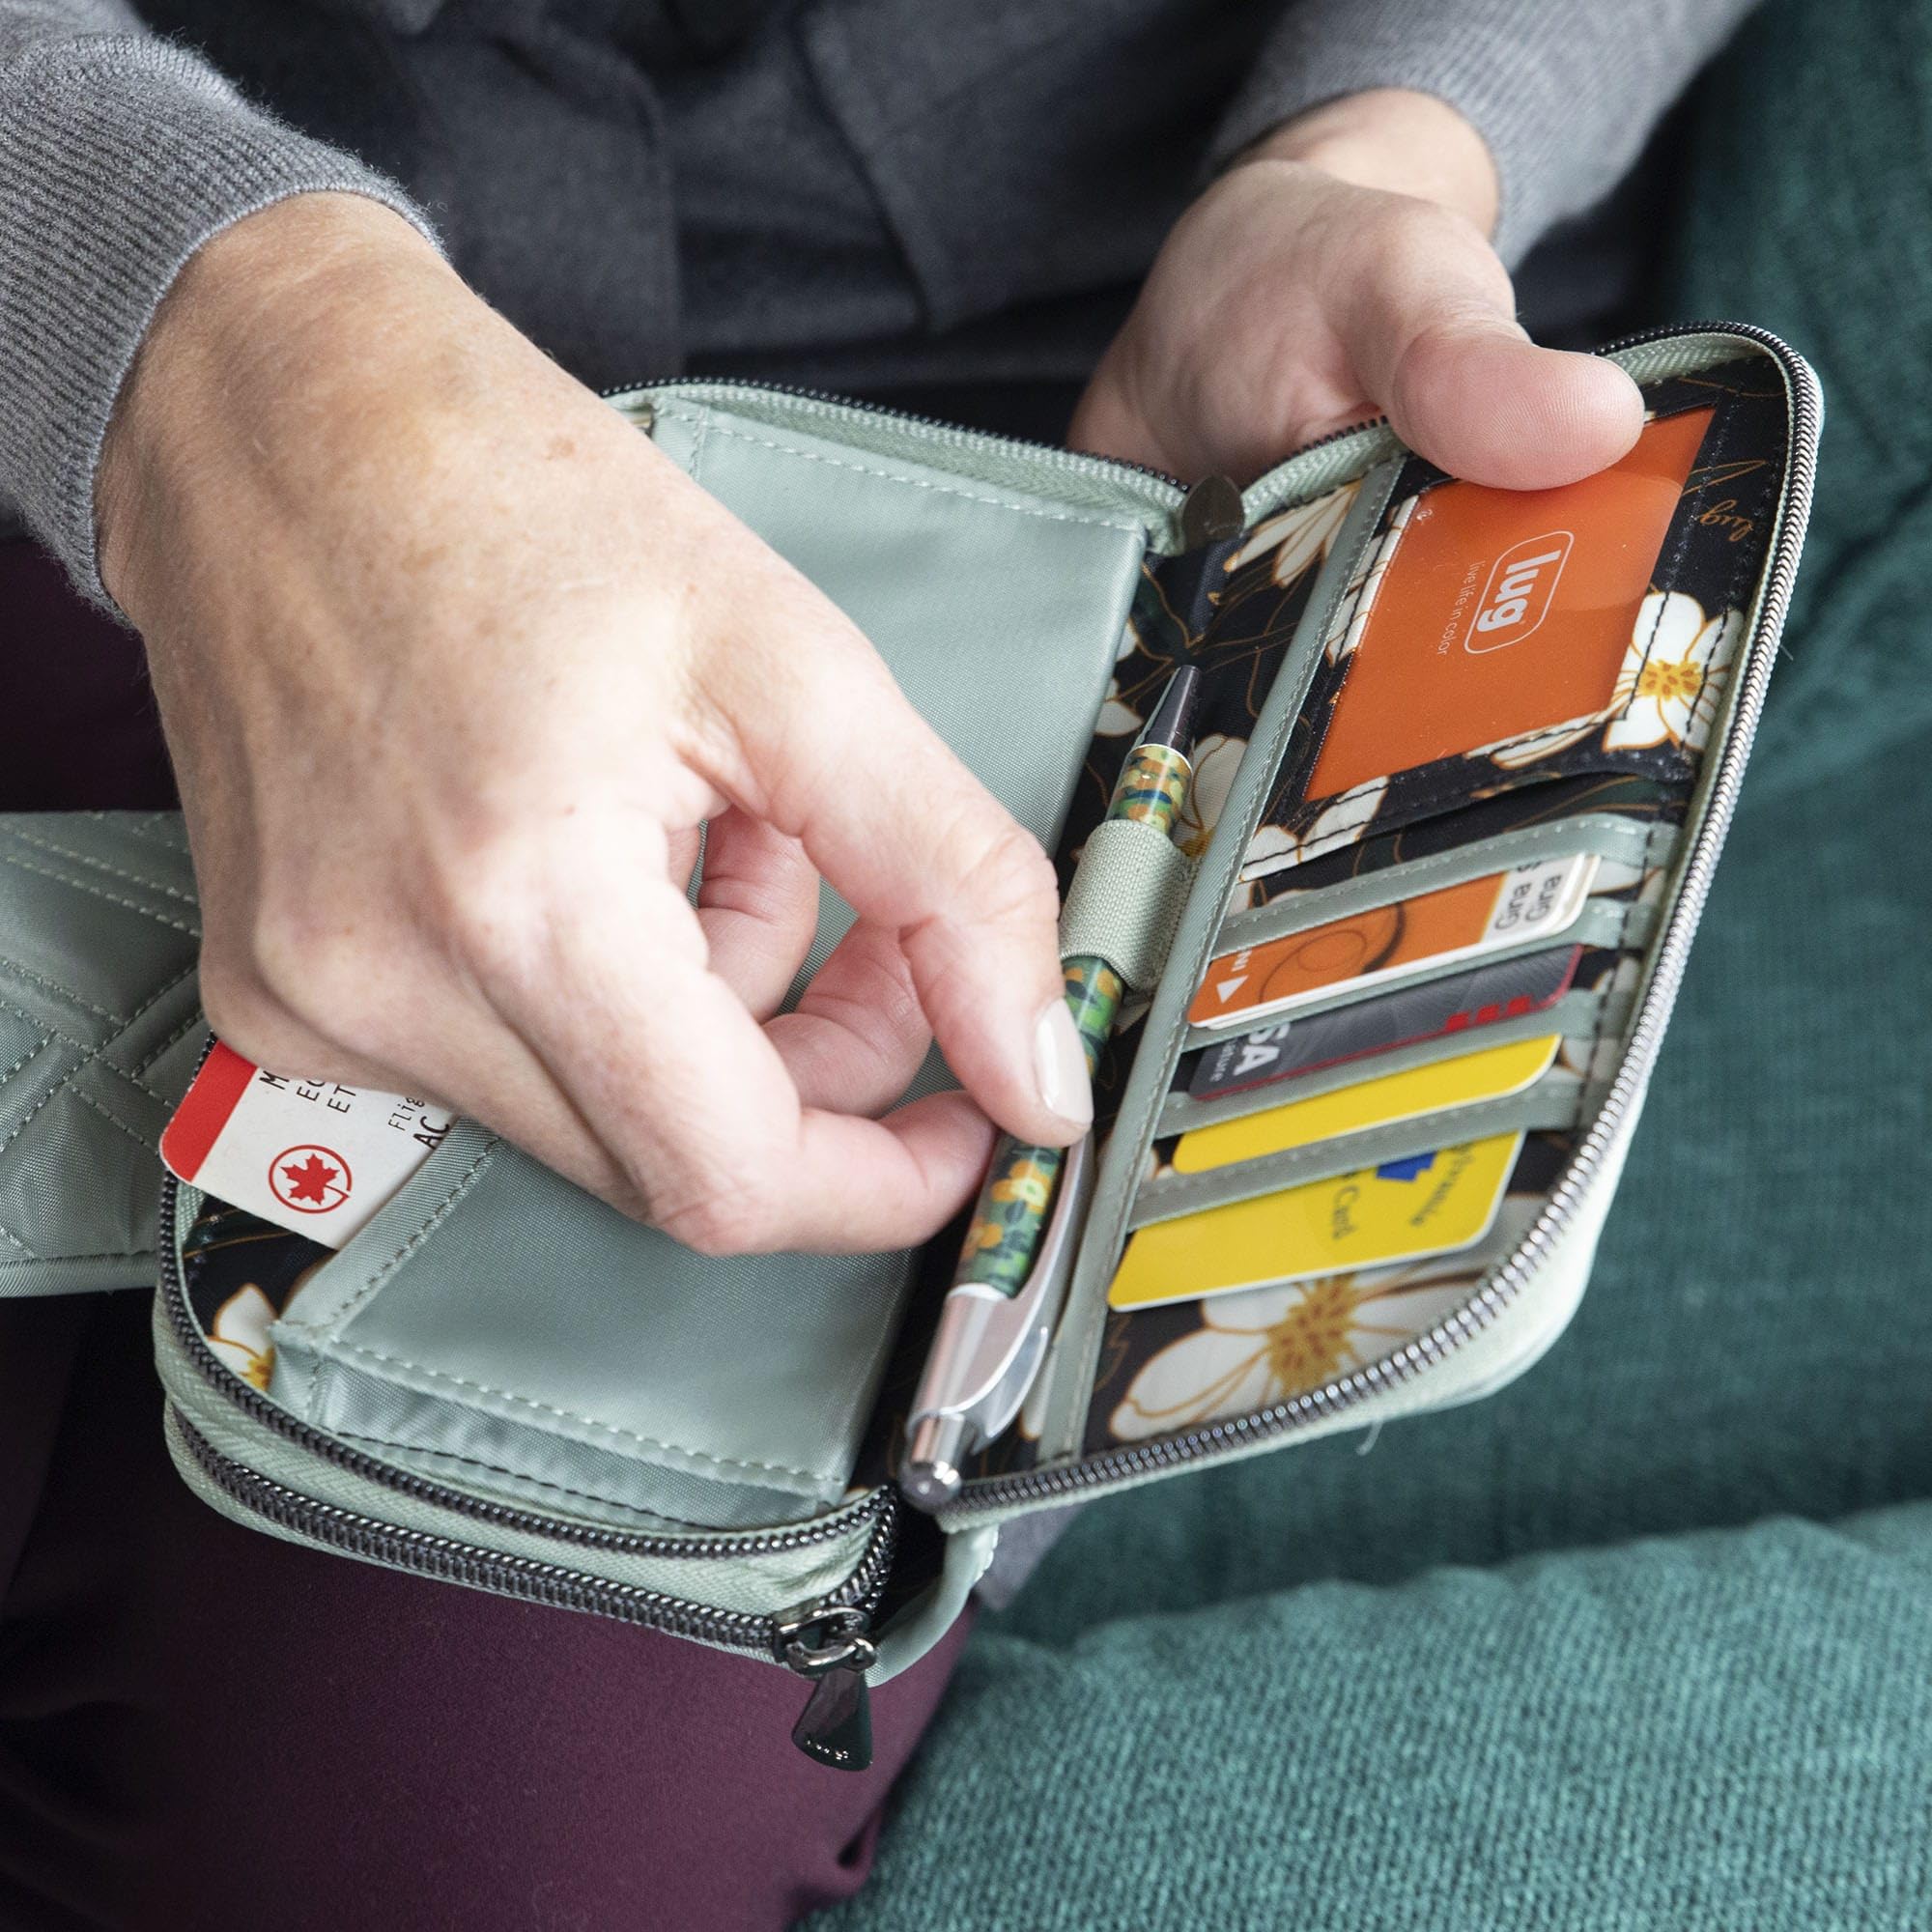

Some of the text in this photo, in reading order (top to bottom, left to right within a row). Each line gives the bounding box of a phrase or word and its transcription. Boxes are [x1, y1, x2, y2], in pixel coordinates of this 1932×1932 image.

[1437, 560, 1486, 656] live life in color
[1476, 549, 1562, 633] lug
